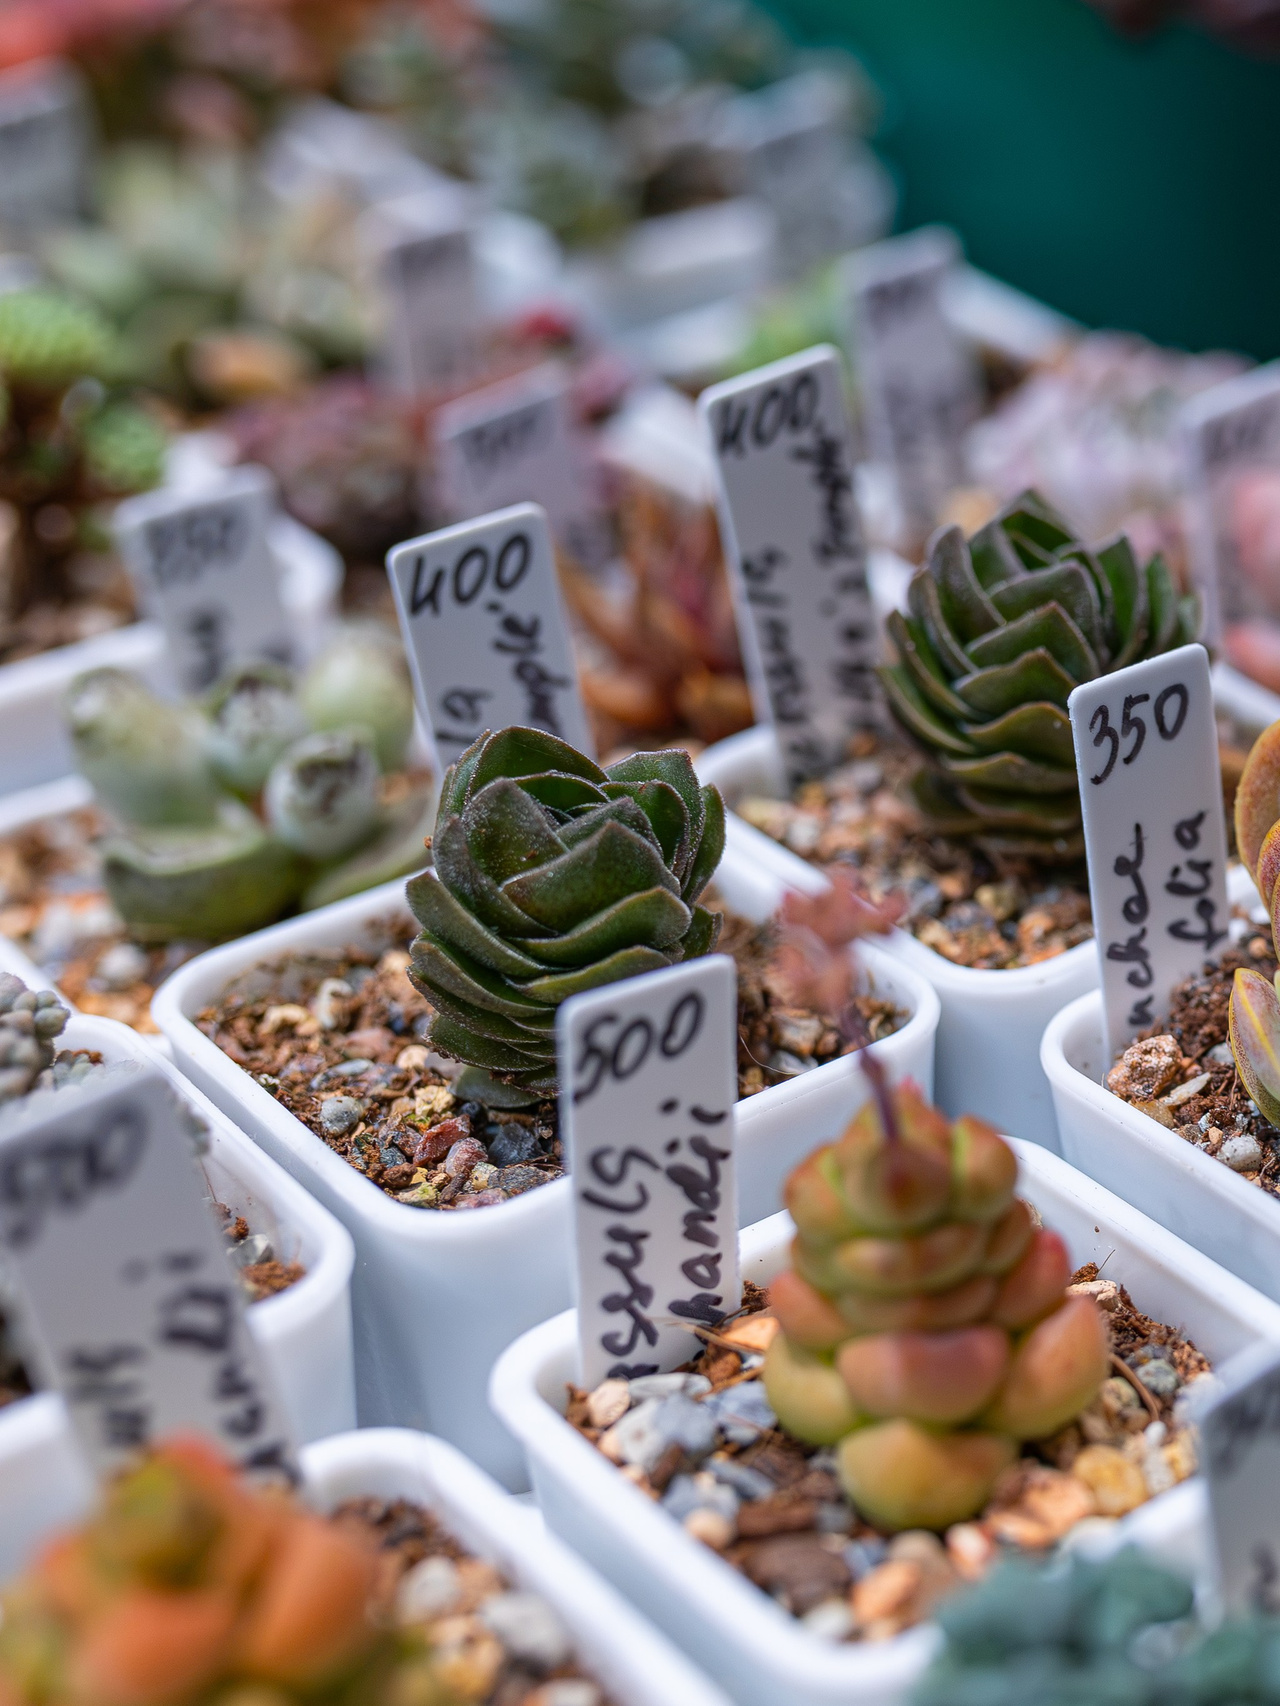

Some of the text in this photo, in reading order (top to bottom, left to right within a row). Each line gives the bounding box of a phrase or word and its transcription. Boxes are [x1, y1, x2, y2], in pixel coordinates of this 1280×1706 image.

[408, 531, 533, 617] 400
[1089, 683, 1190, 786] 350
[573, 992, 707, 1104] 500
